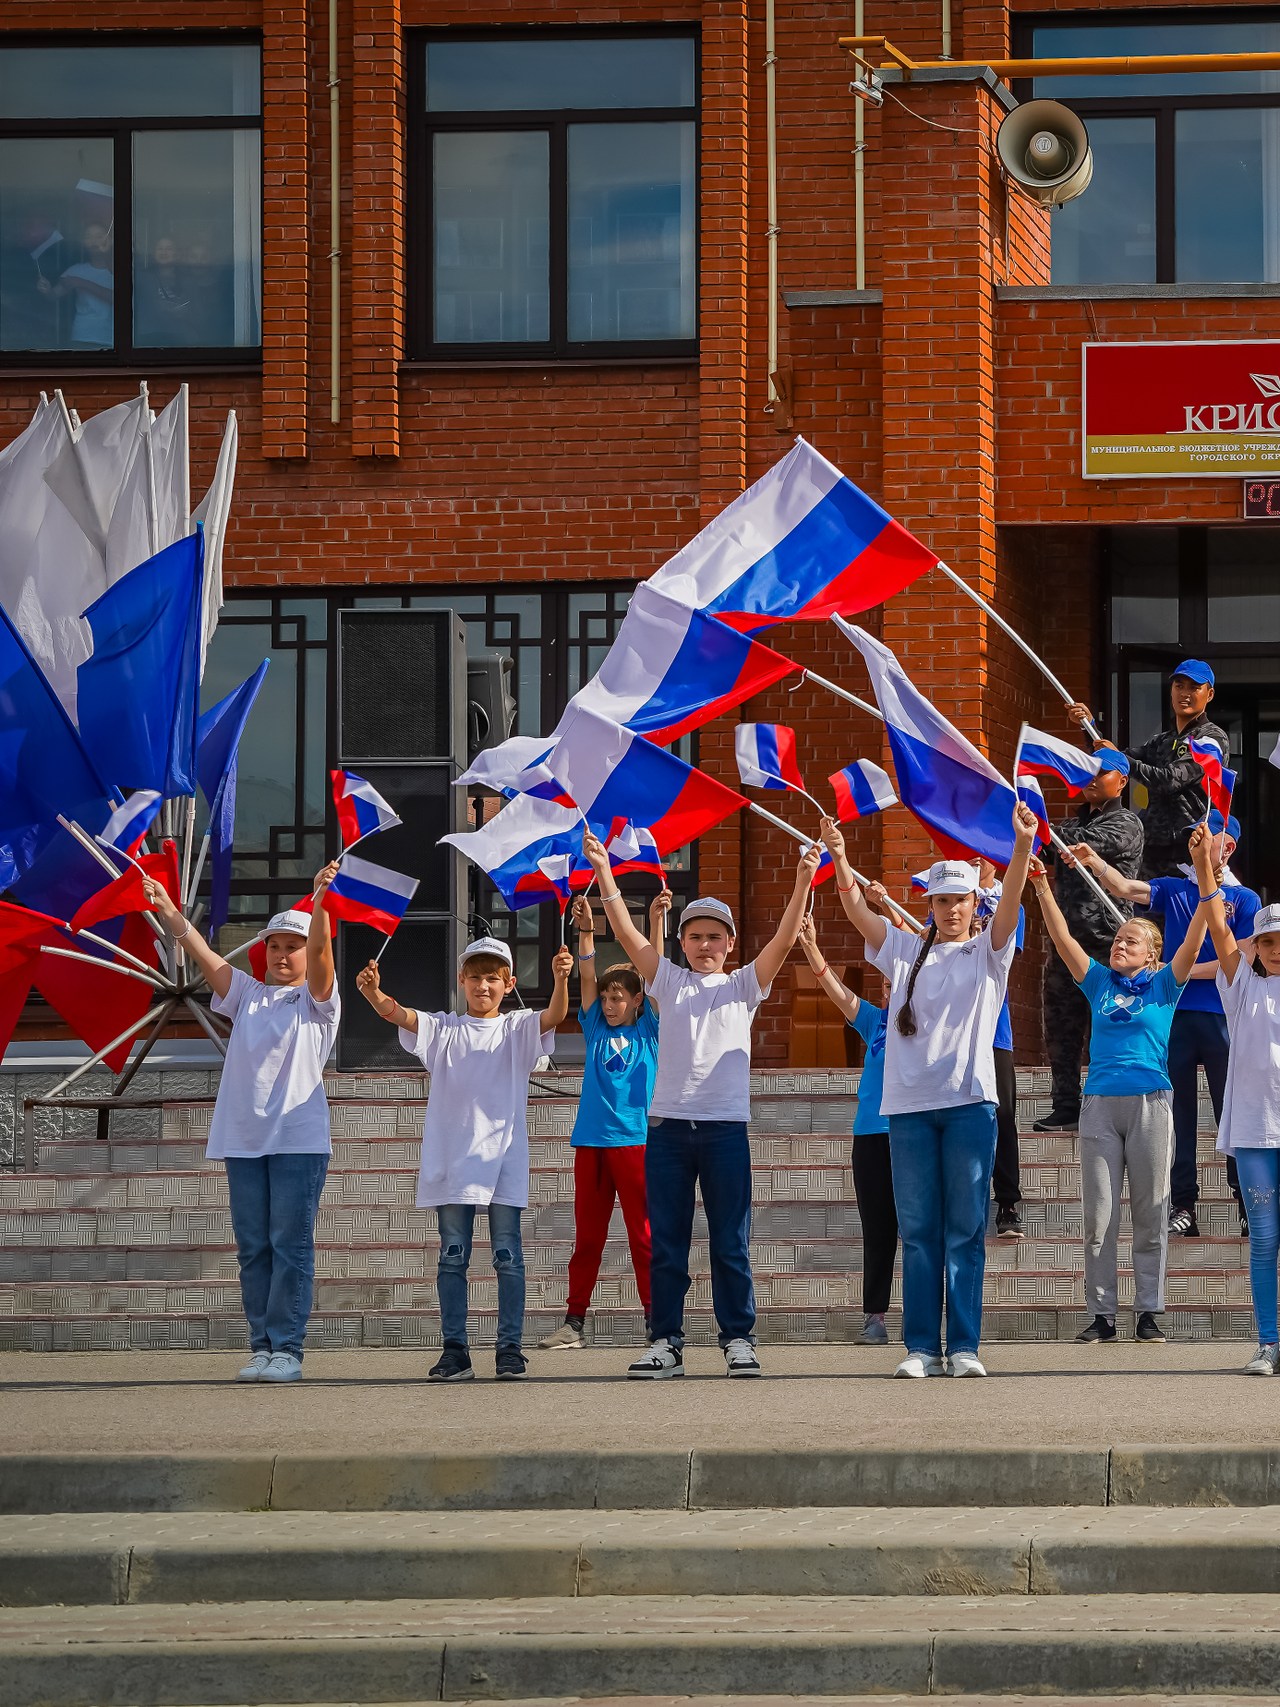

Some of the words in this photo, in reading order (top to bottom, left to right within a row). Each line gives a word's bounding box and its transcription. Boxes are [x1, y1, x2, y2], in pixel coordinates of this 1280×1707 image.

[1090, 445, 1176, 455] МУНИЦИПАЛЬНОЕ
[1179, 444, 1240, 453] БЮДЖЕТНОЕ
[1190, 453, 1256, 462] ГОРОДСКОГО
